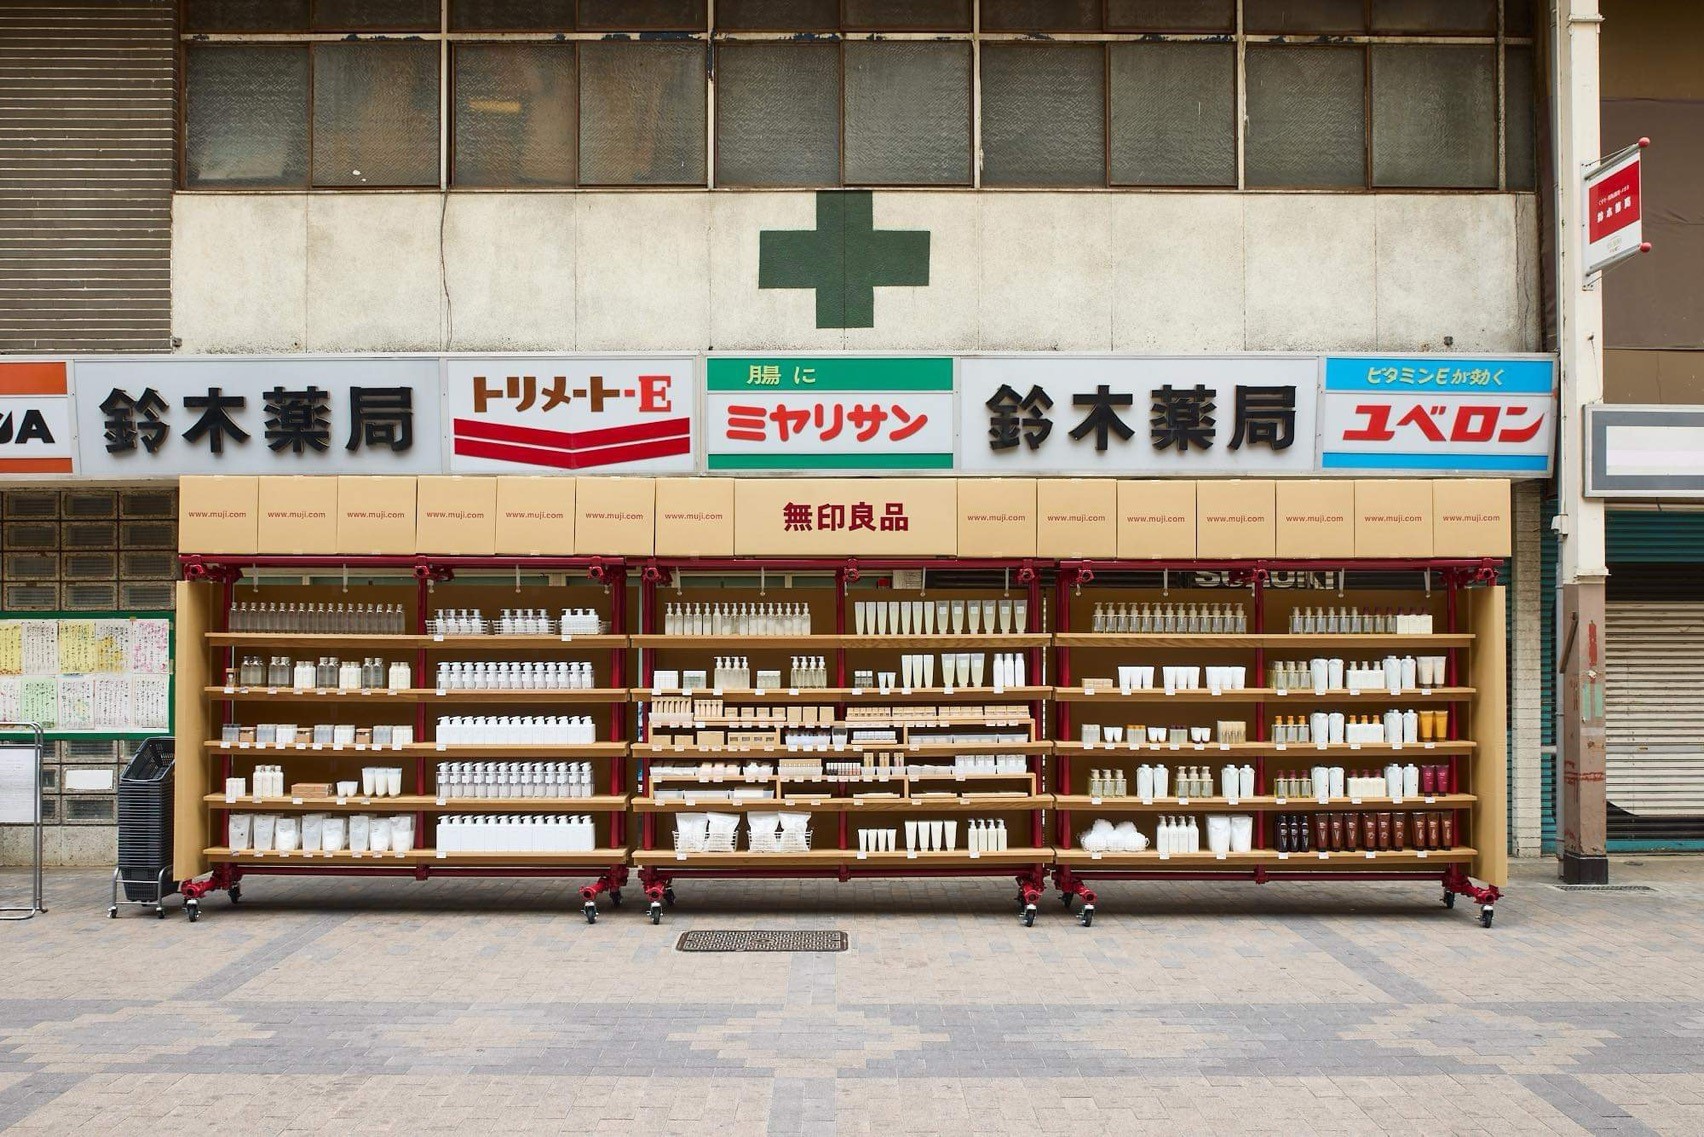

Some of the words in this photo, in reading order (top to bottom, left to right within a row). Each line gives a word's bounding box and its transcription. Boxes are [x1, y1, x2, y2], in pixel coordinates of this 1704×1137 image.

[100, 386, 413, 455] 鈴木薬局
[726, 403, 928, 442] ミヤリサン
[986, 384, 1297, 452] 鈴木薬局
[1342, 404, 1543, 442] ユベロン
[188, 510, 246, 520] www.muji.com
[268, 510, 326, 520] www.muji.com
[347, 510, 405, 520] www.muji.com
[426, 510, 484, 520] www.muji.com
[506, 511, 564, 521] www.muji.com
[586, 511, 644, 521] www.muji.com
[665, 512, 723, 522] www.muji.com
[783, 501, 909, 532] 無印良品
[967, 513, 1026, 523] www.muji.com
[1047, 513, 1106, 523] www.muji.com
[1127, 514, 1185, 524] www.muji.com
[1206, 514, 1265, 524] www.muji.com
[1286, 514, 1344, 524] www.muji.com
[1365, 514, 1423, 524] www.muji.com
[1443, 513, 1501, 523] www.muji.com
